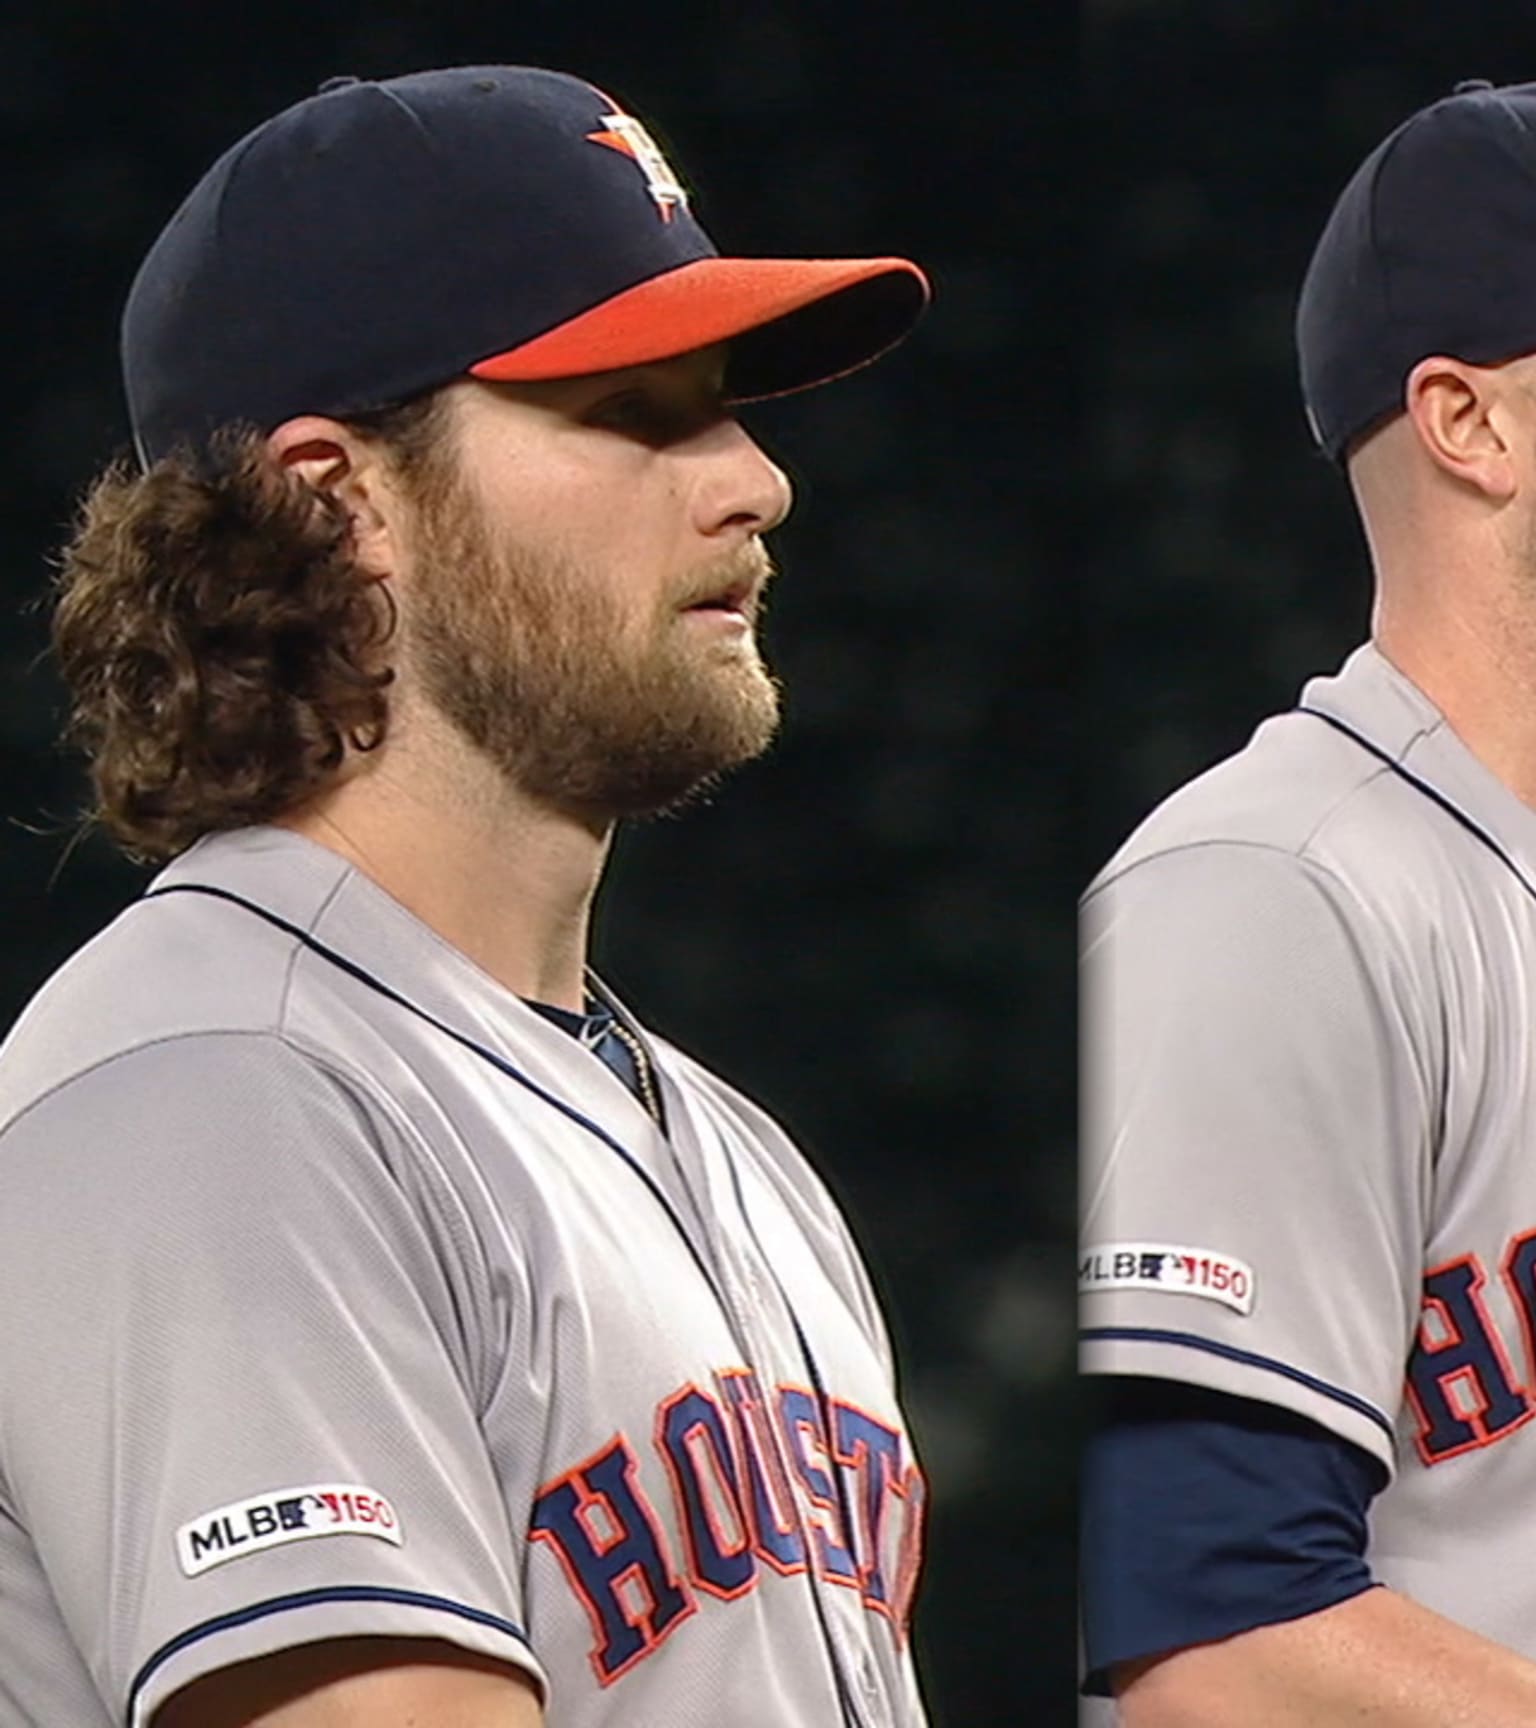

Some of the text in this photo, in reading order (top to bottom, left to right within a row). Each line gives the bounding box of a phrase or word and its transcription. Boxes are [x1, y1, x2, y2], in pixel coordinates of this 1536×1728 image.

[1200, 1258, 1248, 1299] 150
[189, 1493, 394, 1561] MLB 150
